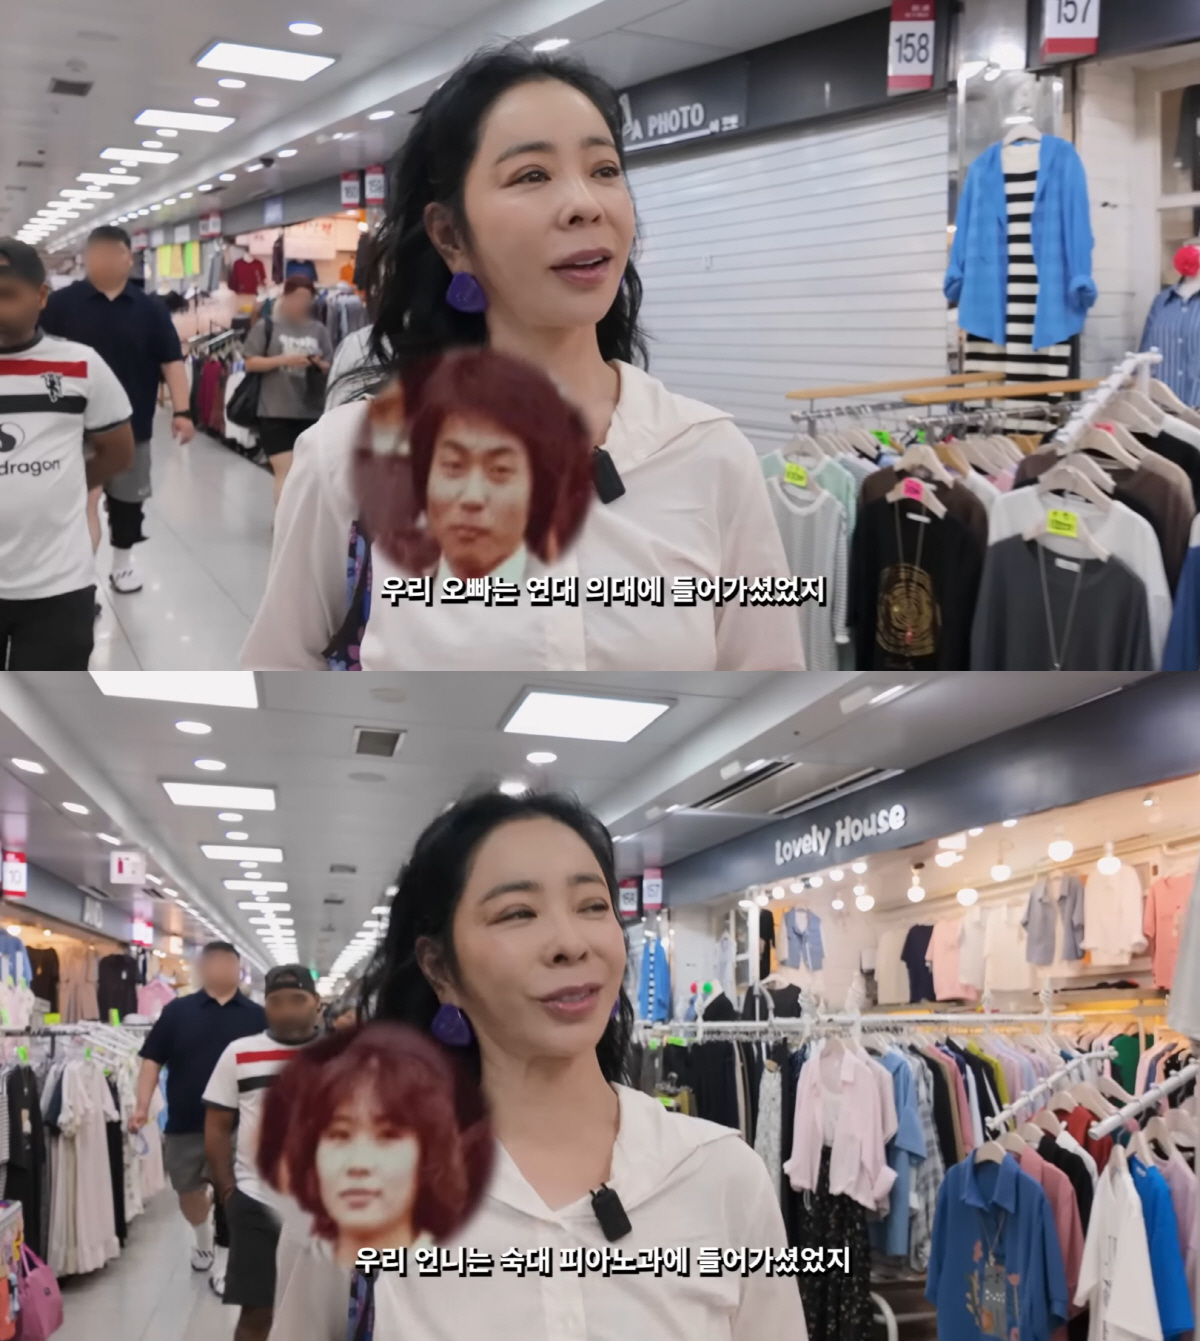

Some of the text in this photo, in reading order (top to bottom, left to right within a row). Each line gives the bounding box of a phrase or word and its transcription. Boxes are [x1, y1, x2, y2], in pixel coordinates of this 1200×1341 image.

[1057, 0, 1092, 24] 157
[894, 32, 930, 64] 158
[647, 102, 705, 137] PHOTO
[775, 803, 905, 867] Lovely House
